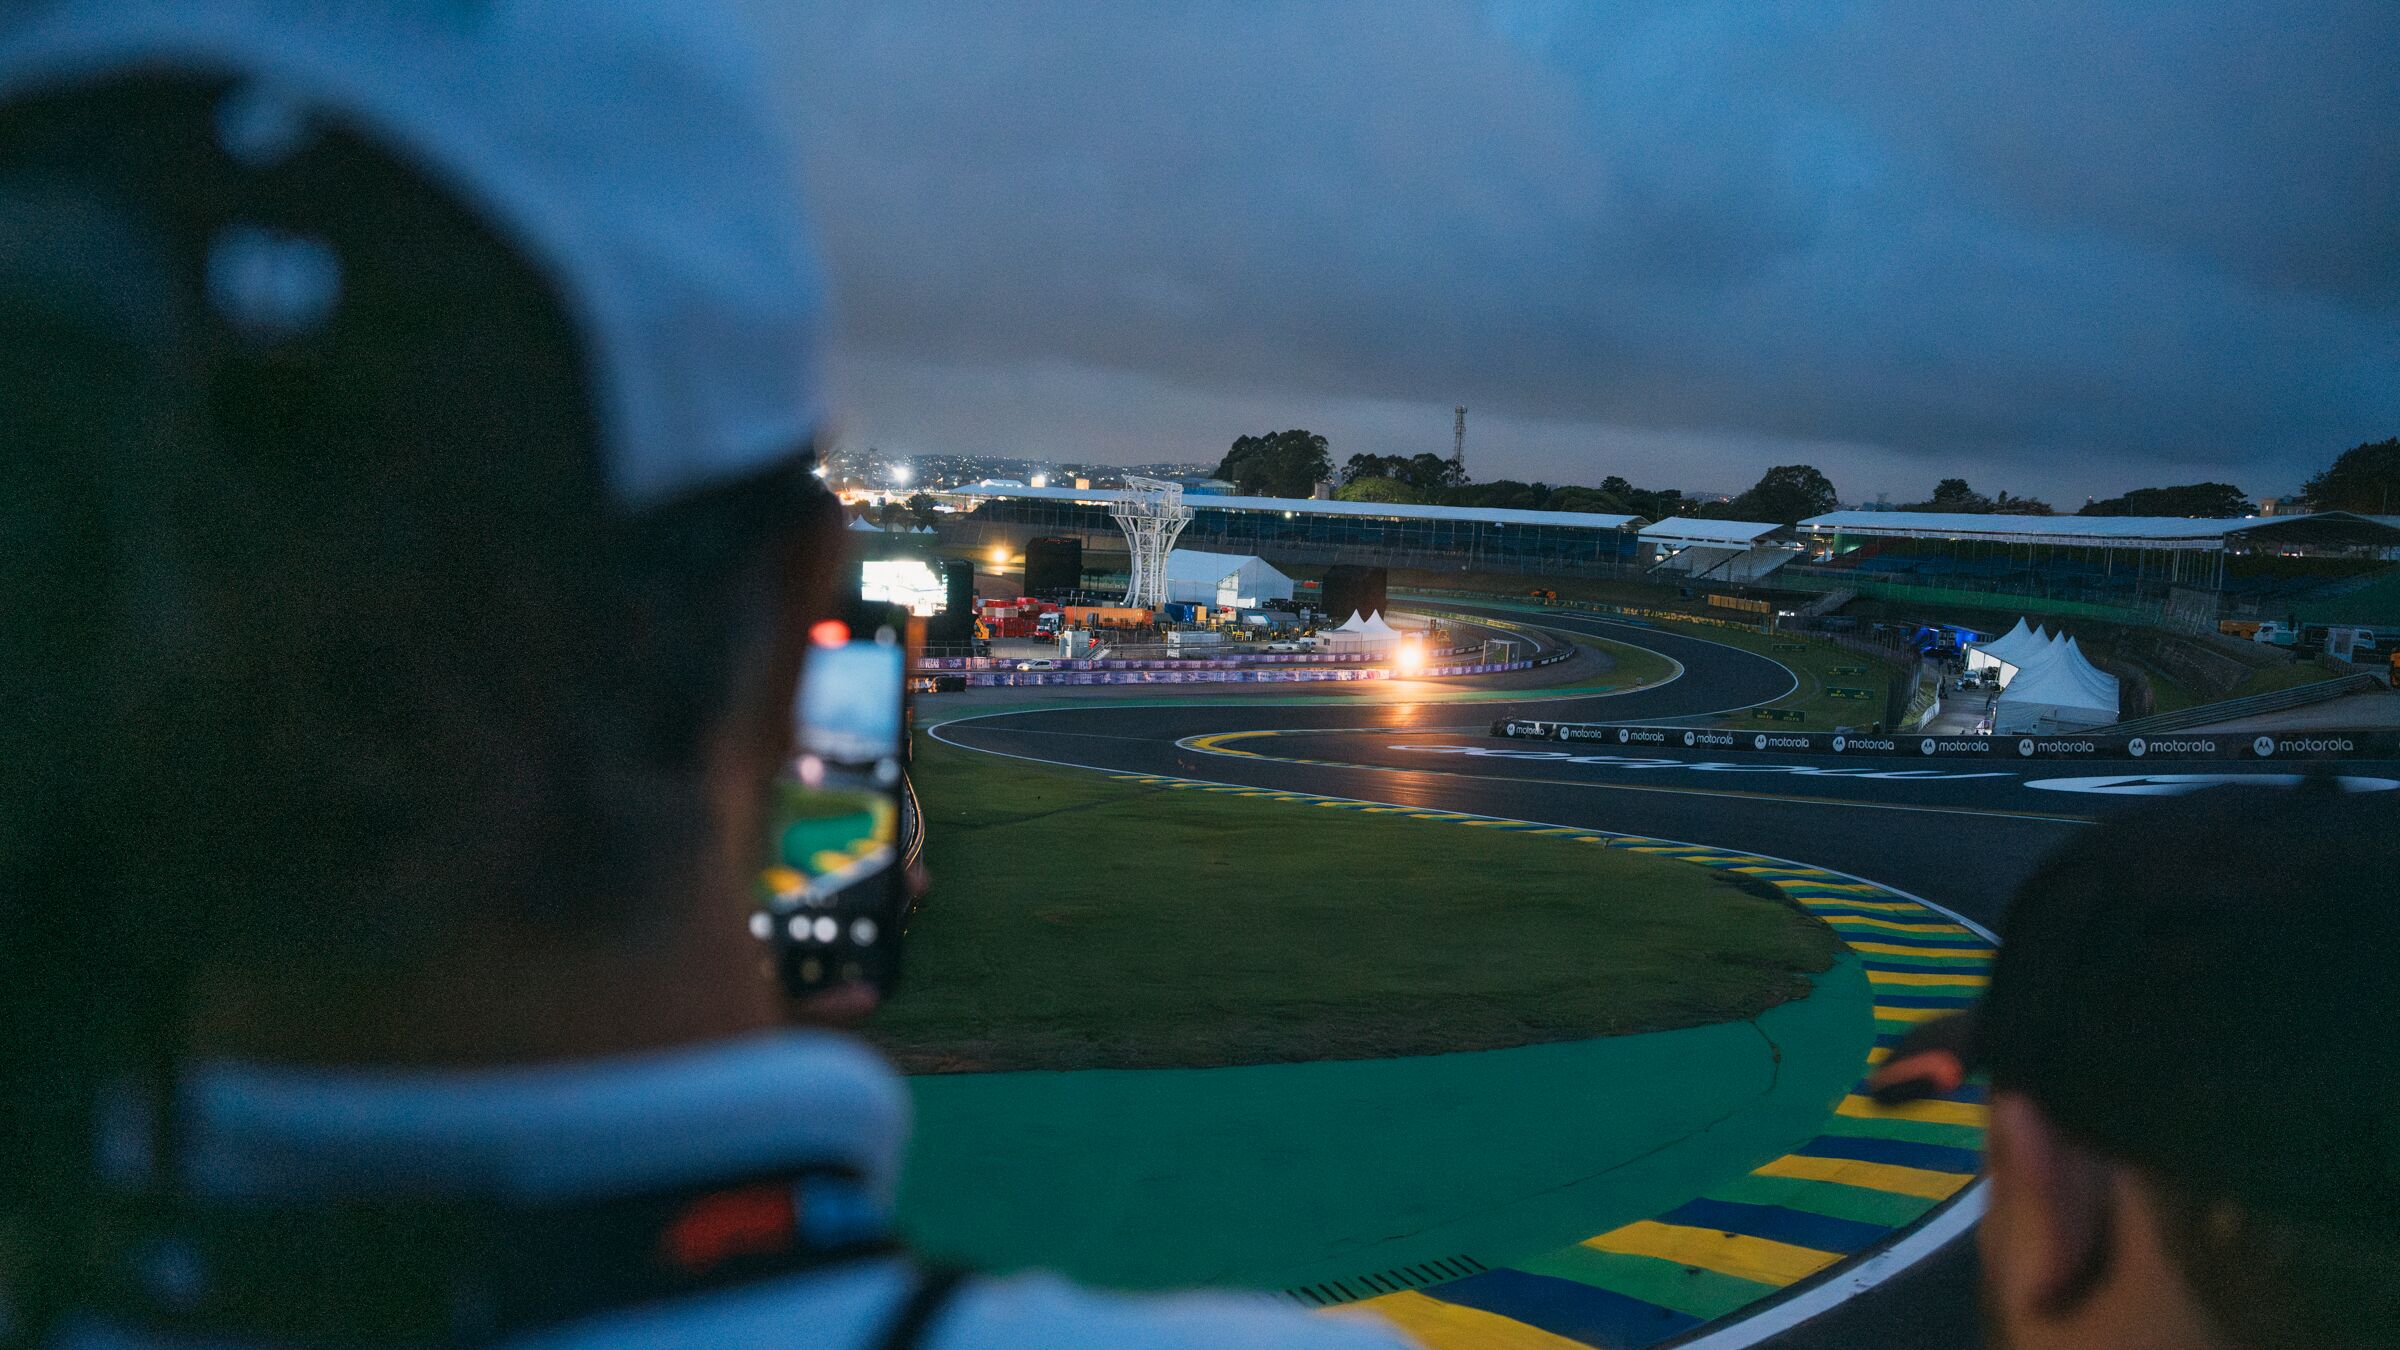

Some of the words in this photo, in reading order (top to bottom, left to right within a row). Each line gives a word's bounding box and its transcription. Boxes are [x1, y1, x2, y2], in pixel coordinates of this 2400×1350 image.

[1570, 729, 1602, 739] motorola
[1630, 731, 1665, 743] motorola
[1696, 734, 1734, 746] motorola
[1768, 736, 1810, 749] motorola
[1847, 739, 1895, 752] motorola
[1938, 740, 1990, 753] motorola
[2037, 740, 2095, 753] motorola
[2149, 739, 2216, 753] motorola
[2279, 737, 2354, 753] motorola
